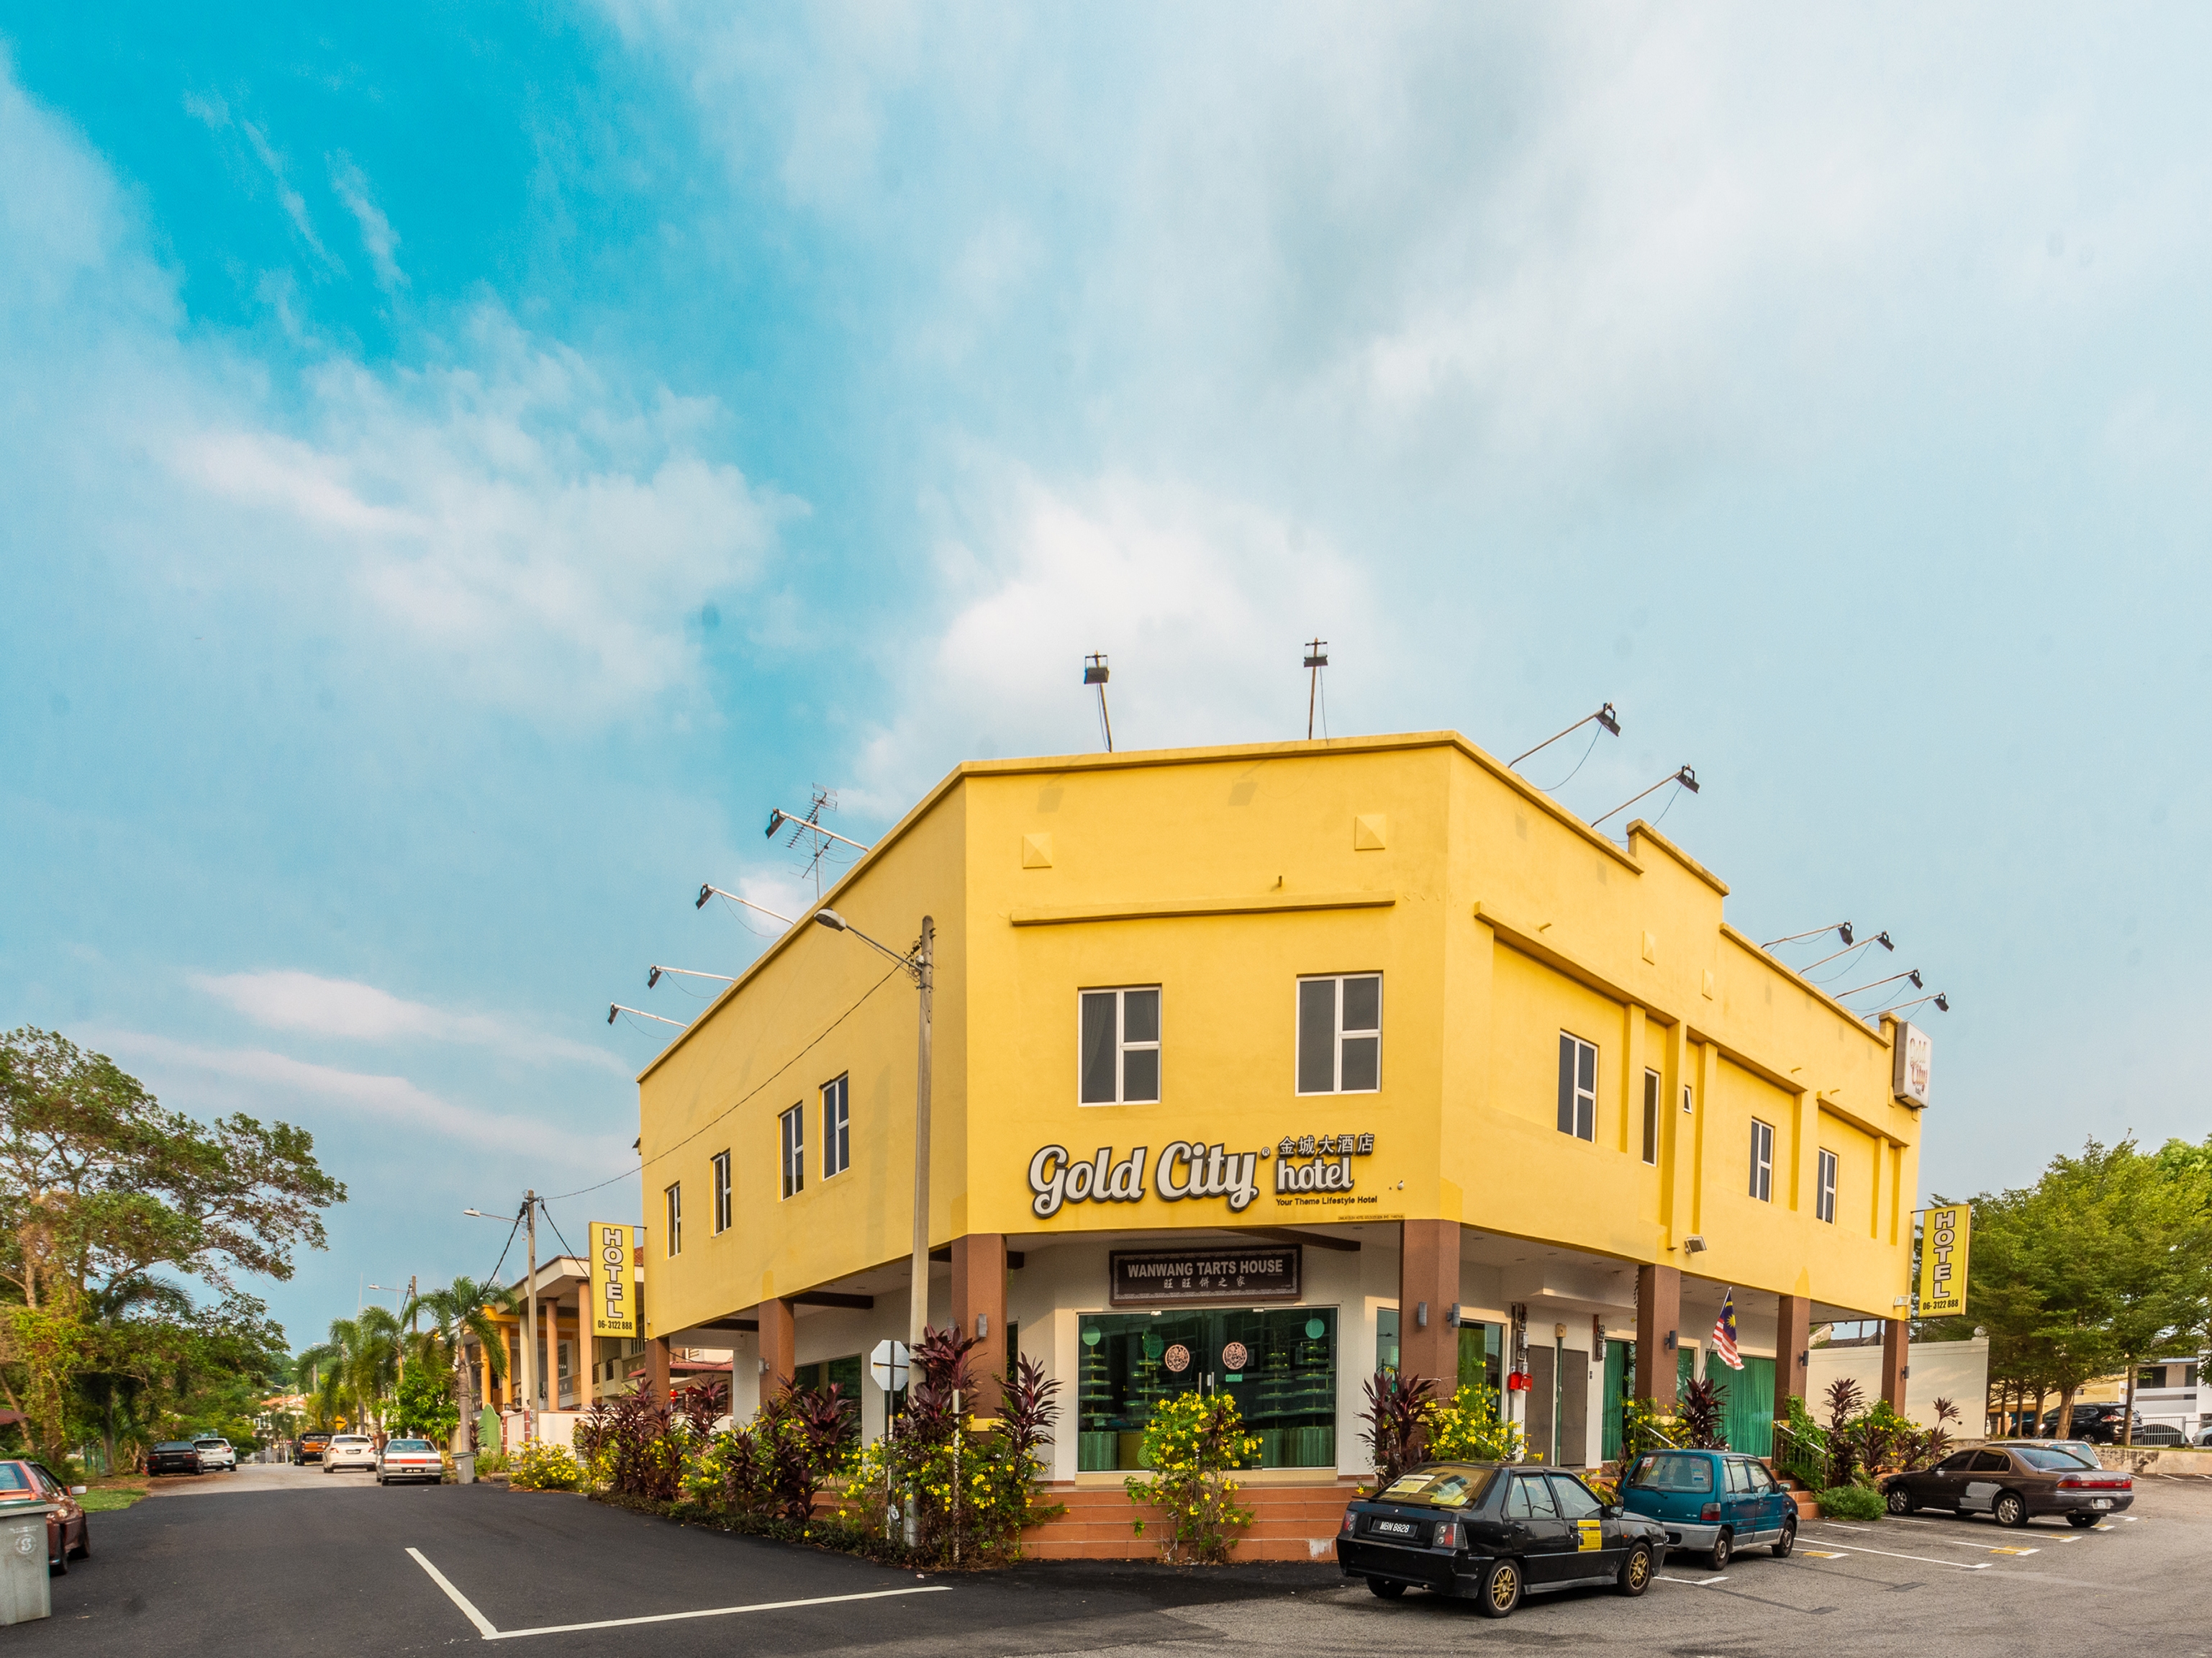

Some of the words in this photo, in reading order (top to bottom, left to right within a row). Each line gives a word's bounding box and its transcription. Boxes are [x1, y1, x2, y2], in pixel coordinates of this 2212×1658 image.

[1279, 1133, 1374, 1156] 金城大酒店
[1028, 1144, 1148, 1218] Gold
[1156, 1141, 1259, 1212] City
[1277, 1156, 1354, 1193] hotel
[1322, 1196, 1355, 1205] Lifestyle
[1357, 1195, 1377, 1204] Hotel
[1933, 1210, 1955, 1299] HOTEL
[603, 1228, 624, 1318] HOTEL
[1128, 1262, 1194, 1277] WANWANG
[1197, 1261, 1236, 1275] TARTS
[1240, 1259, 1283, 1274] HOUSE
[1934, 1300, 1946, 1309] 3122
[1947, 1298, 1959, 1307] 888
[608, 1320, 621, 1329] 3122
[622, 1321, 633, 1330] 888
[1642, 1457, 1653, 1467] P
[1392, 1523, 1410, 1533] 8828
